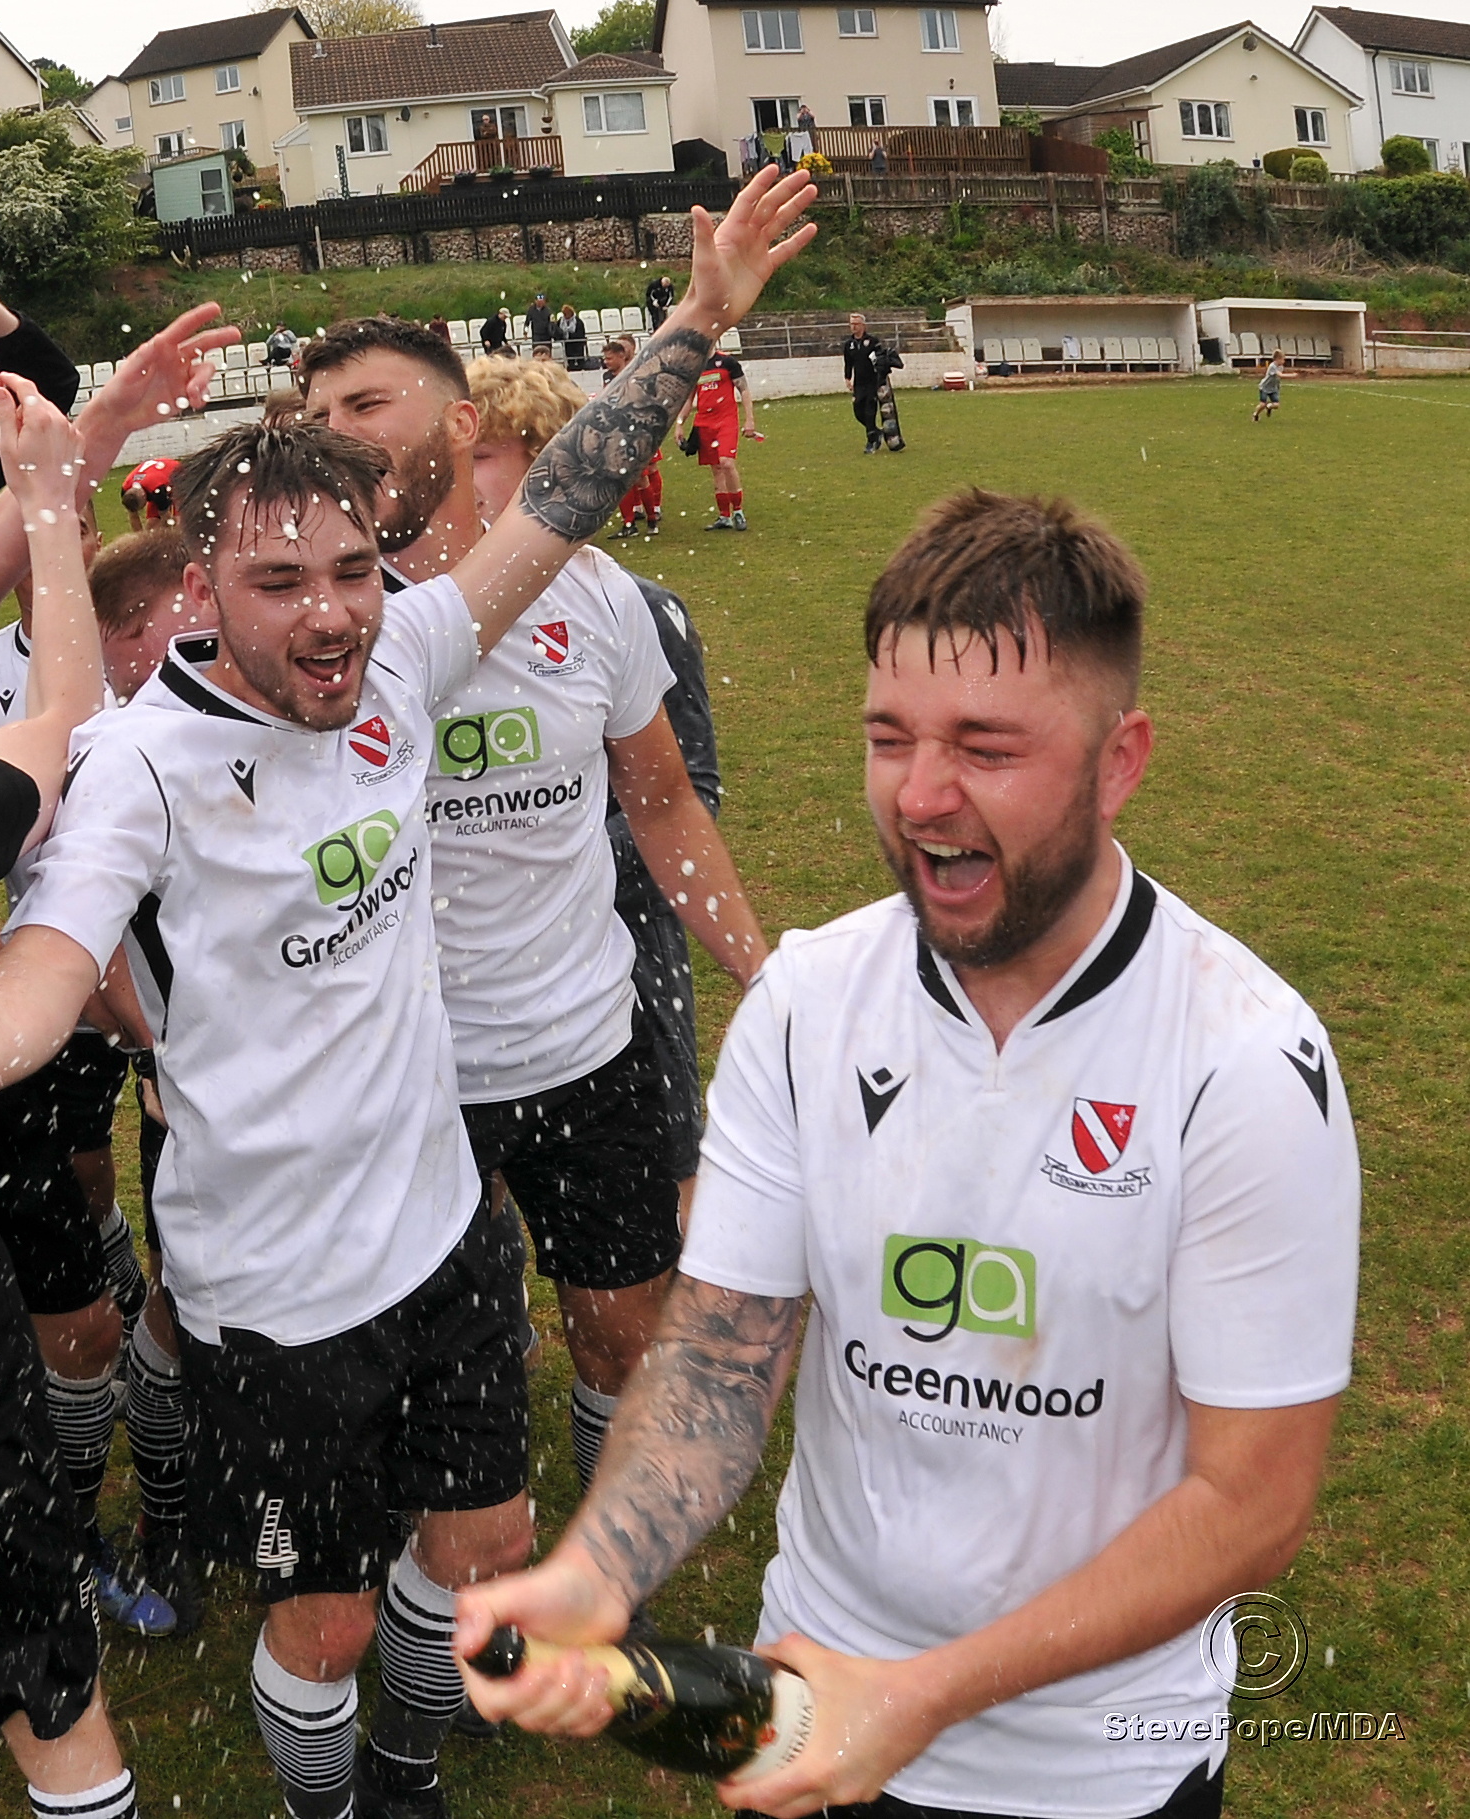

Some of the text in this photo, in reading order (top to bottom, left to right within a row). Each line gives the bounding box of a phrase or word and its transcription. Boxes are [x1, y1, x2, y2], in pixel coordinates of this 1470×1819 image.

[443, 712, 534, 781] ga
[425, 772, 583, 823] reenwood
[455, 815, 540, 837] ACCOUNTANCY
[333, 909, 401, 969] ACCOUNTANCY
[893, 1242, 1026, 1343] ga
[844, 1339, 1105, 1418] Greenwood
[898, 1410, 1024, 1445] ACCOUNTANCY
[255, 1498, 299, 1579] 4
